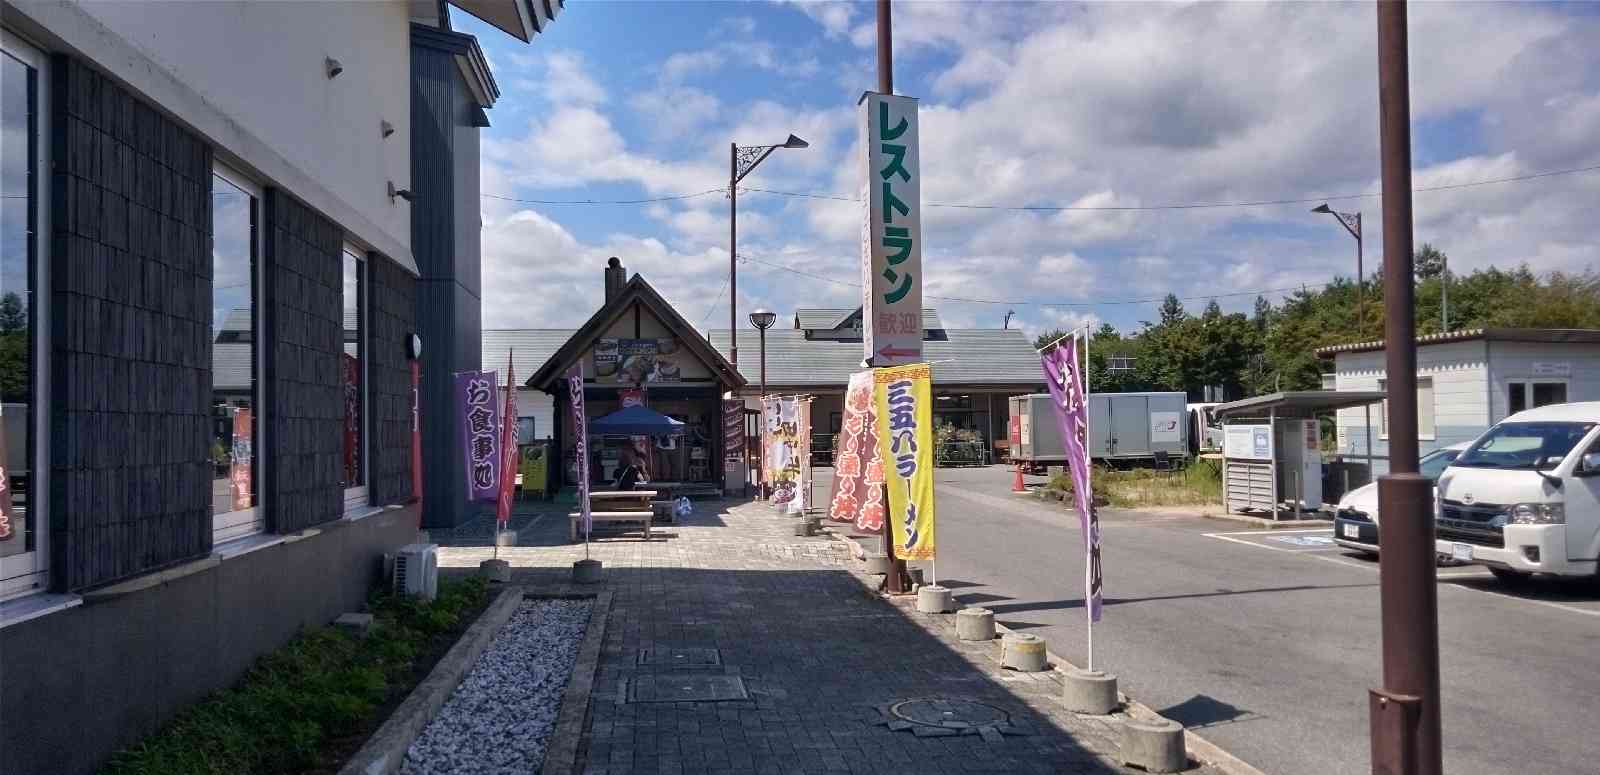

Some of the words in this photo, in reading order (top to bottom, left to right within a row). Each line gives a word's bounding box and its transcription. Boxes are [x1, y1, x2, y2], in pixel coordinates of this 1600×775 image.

[879, 101, 914, 305] レストラン
[878, 311, 918, 335] 歓迎
[465, 378, 496, 490] お食事処
